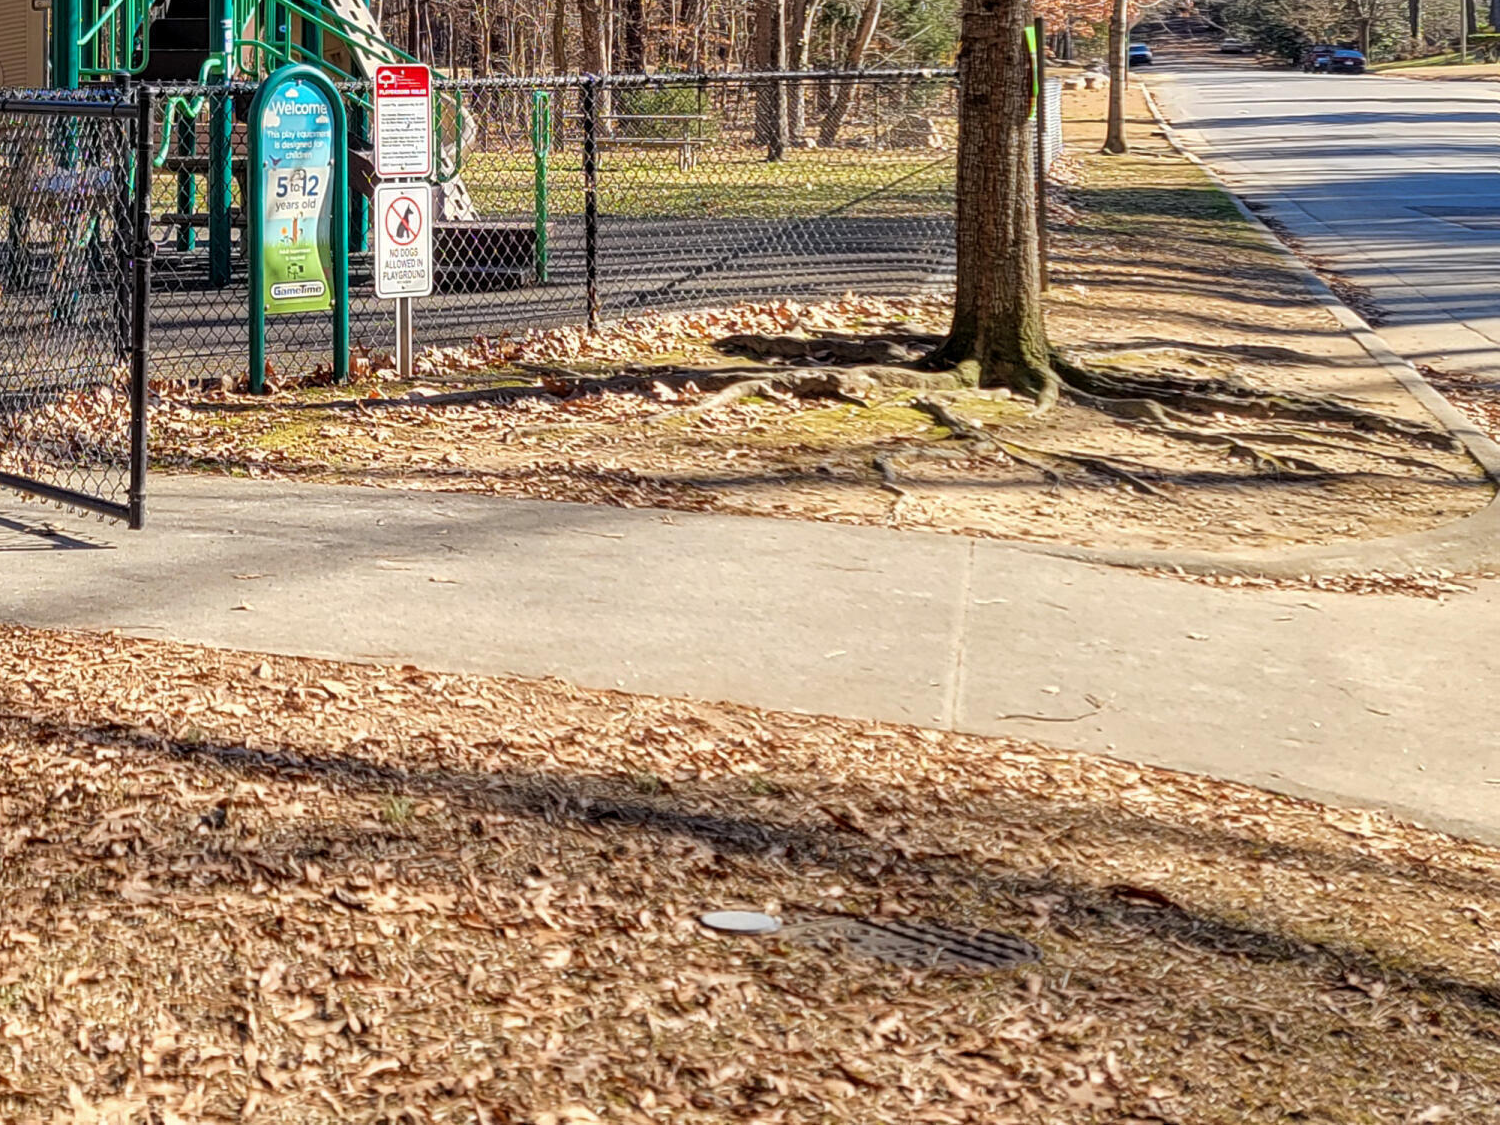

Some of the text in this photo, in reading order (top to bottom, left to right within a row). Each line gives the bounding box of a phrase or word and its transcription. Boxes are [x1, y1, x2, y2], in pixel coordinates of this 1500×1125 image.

[272, 101, 328, 115] Welcome
[281, 130, 296, 139] play
[276, 175, 319, 197] 5 to 12
[276, 200, 316, 212] years old
[390, 248, 419, 258] NO DOGS
[385, 259, 423, 269] ALLOWED IN
[383, 270, 425, 281] PLAYGROUND
[273, 285, 322, 296] GameTime
